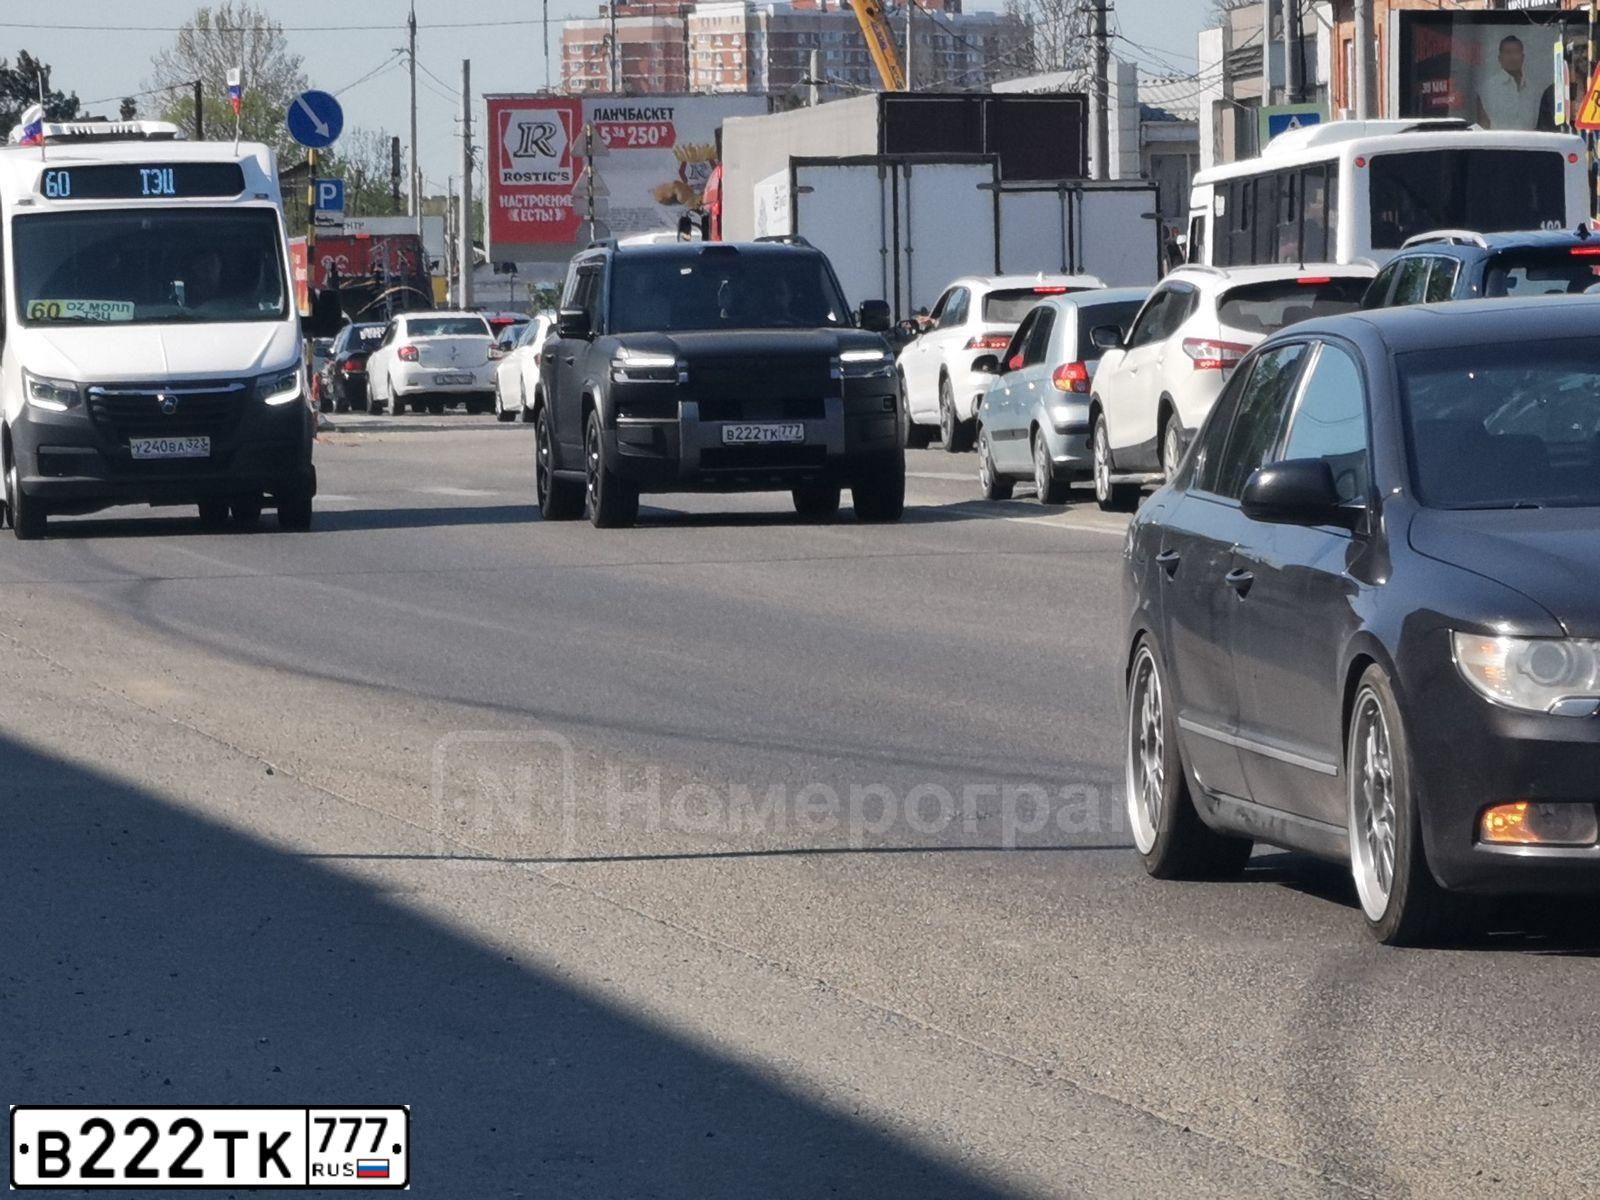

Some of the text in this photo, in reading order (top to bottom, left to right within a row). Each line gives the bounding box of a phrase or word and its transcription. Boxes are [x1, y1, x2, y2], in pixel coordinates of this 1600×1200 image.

[594, 107, 674, 121] ЛАНЧБАСКЕТ
[513, 122, 557, 158] R
[601, 126, 612, 145] 5
[628, 126, 659, 145] 250
[45, 168, 175, 197] 60 ТЭЦ
[503, 172, 570, 182] ROSTIC'S
[500, 194, 573, 208] НАСТРОЕНИЕ
[32, 302, 60, 320] 60
[726, 424, 801, 441] В222ТК 777
